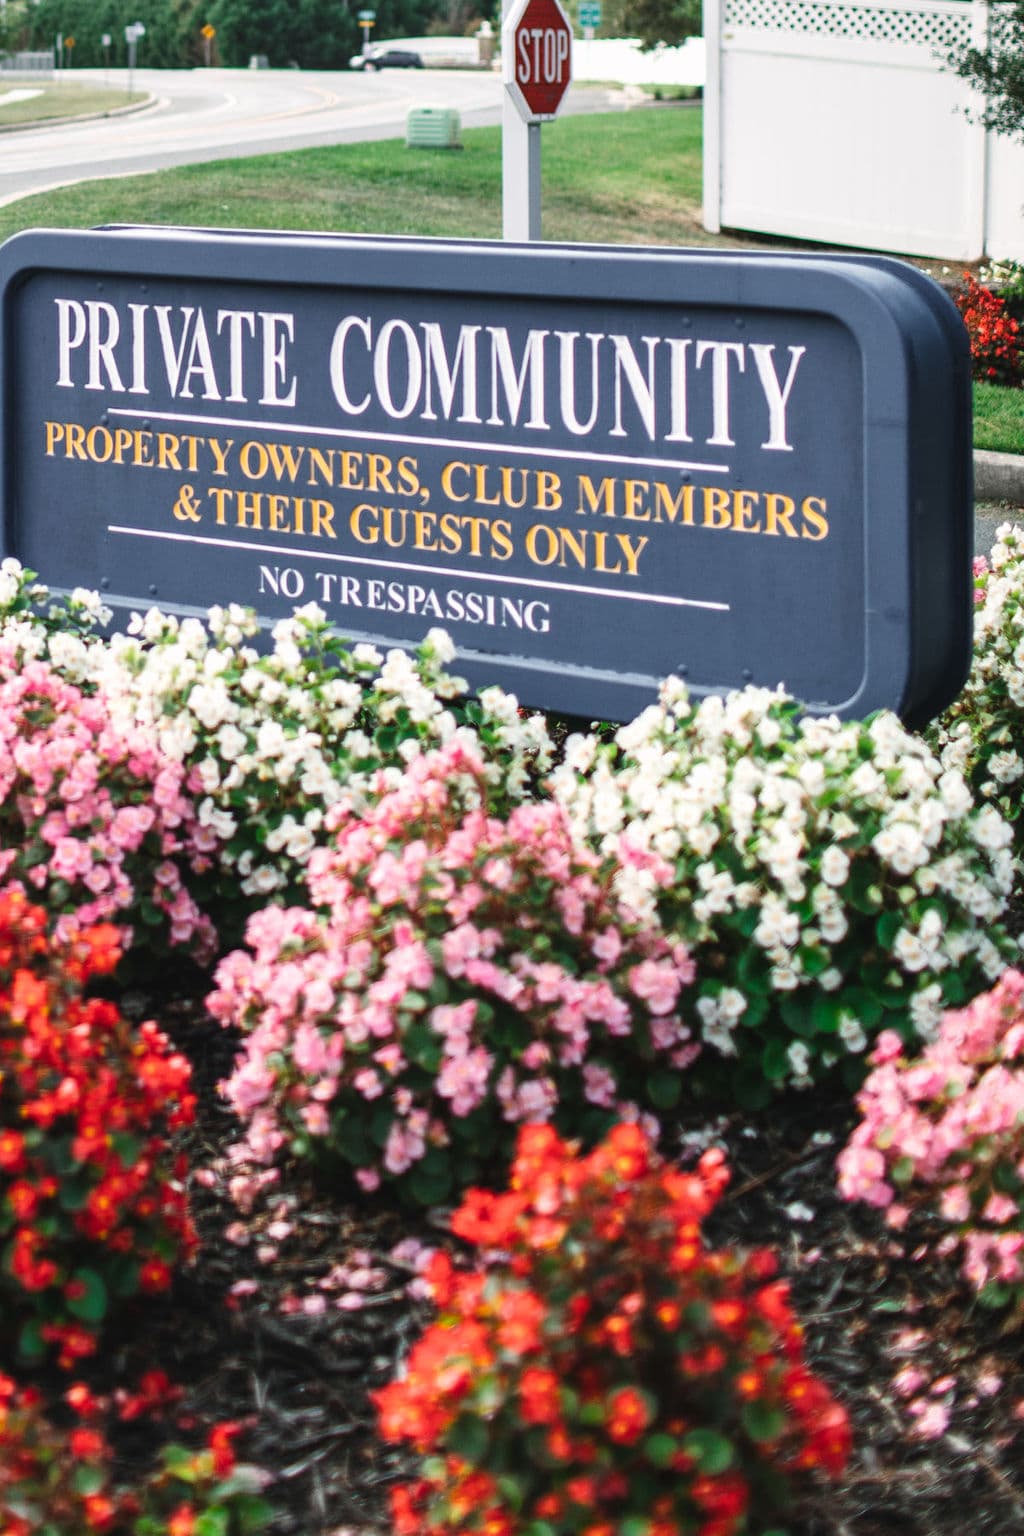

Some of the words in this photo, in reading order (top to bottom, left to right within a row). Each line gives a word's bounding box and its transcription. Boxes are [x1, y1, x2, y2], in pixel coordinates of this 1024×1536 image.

[518, 28, 569, 84] STOP
[54, 297, 297, 408] PRIVATE
[329, 315, 807, 452] COMMUNITY
[44, 421, 235, 477] PROPERTY
[238, 440, 431, 505] OWNERS,
[441, 461, 564, 512] CLUB
[575, 476, 830, 542] MEMBERS
[172, 483, 204, 523] &
[207, 488, 339, 537] THEIR
[349, 502, 514, 562] GUESTS
[525, 525, 649, 576] ONLY
[258, 564, 305, 597] NO
[315, 573, 552, 633] TRESPASSING
